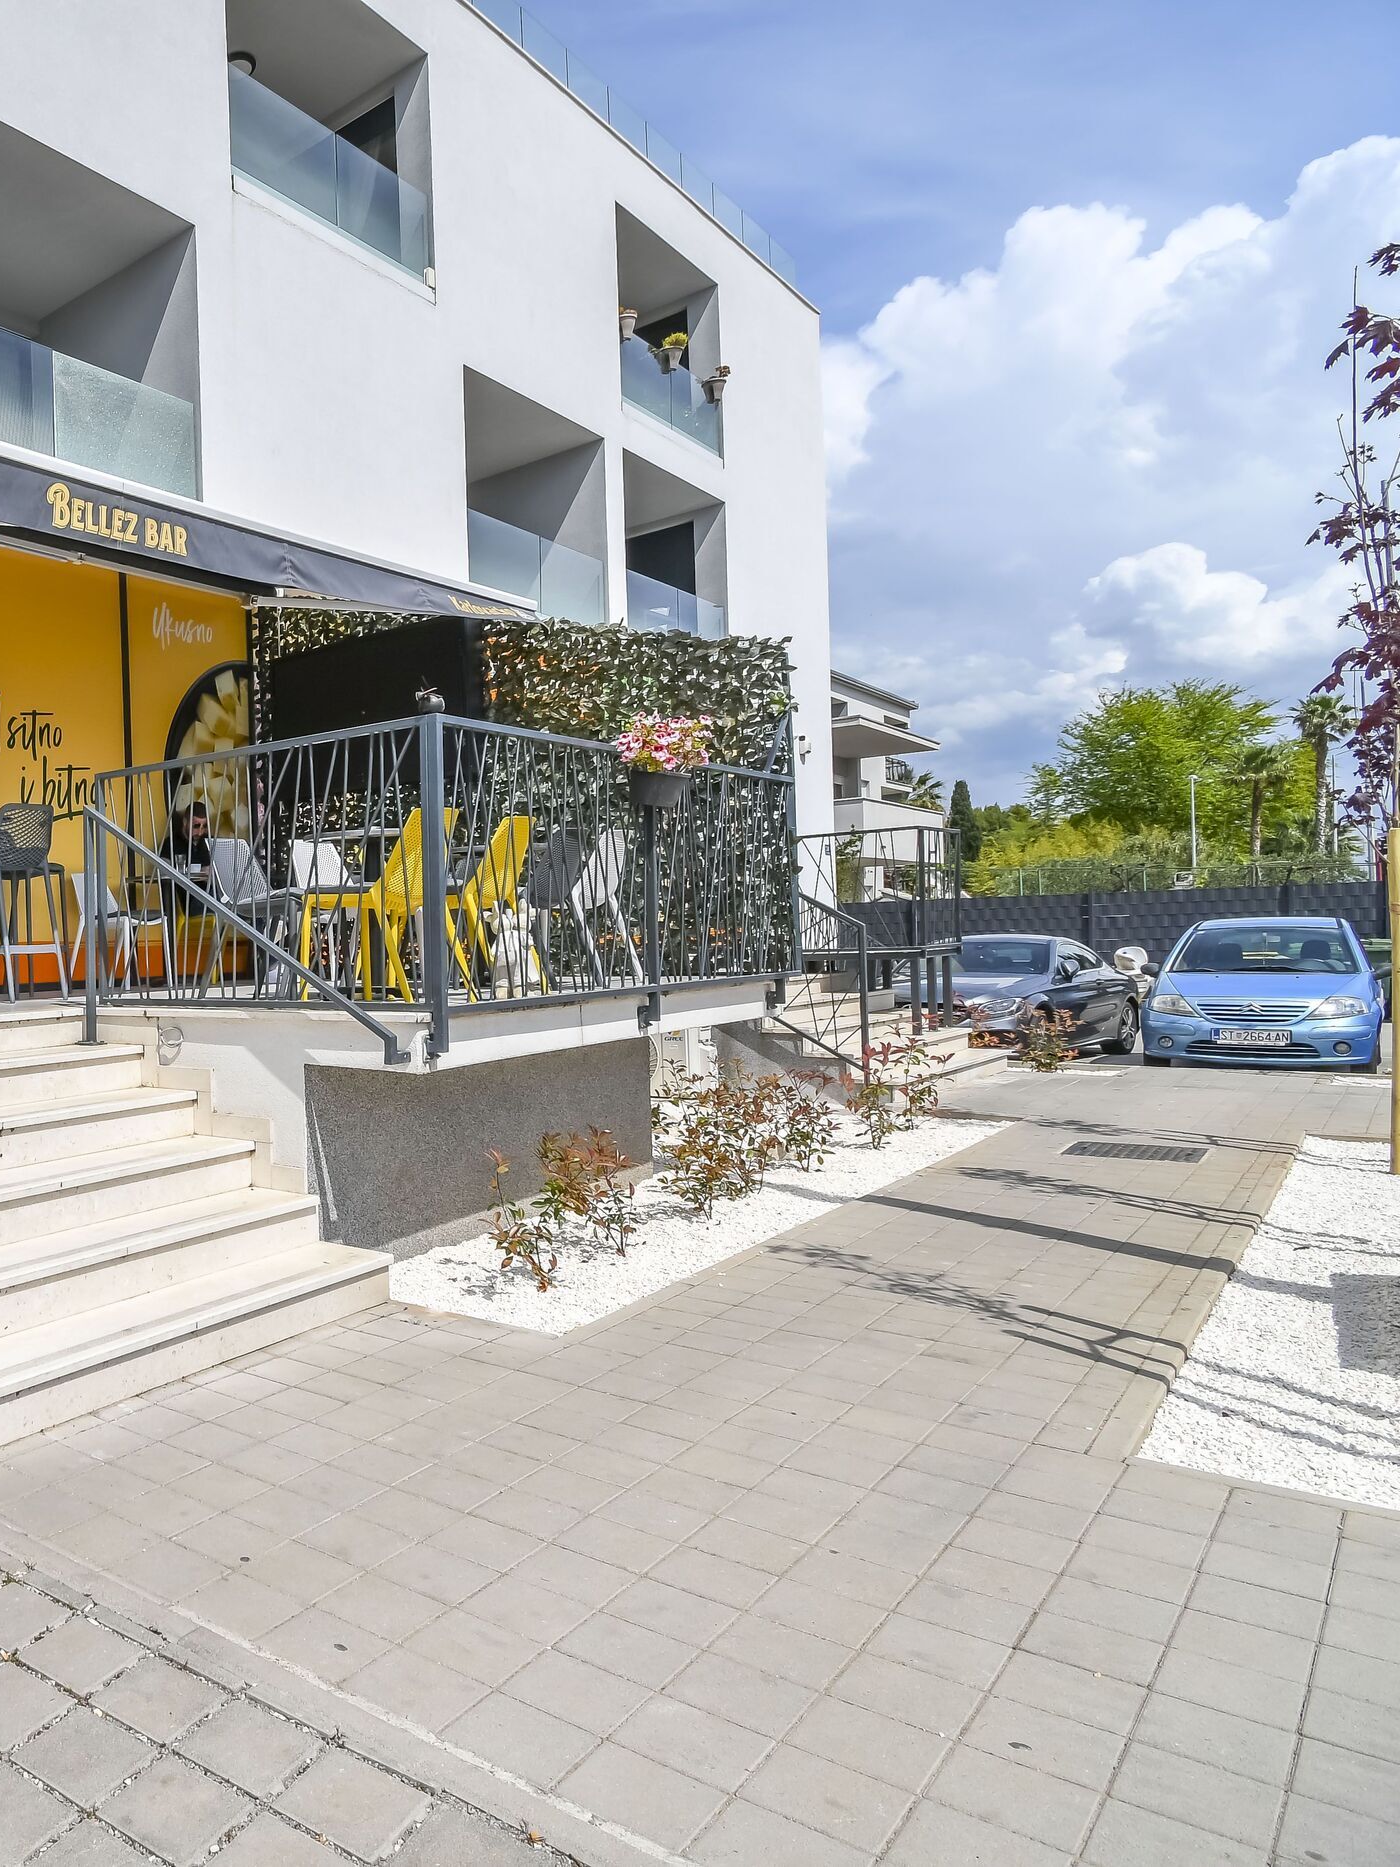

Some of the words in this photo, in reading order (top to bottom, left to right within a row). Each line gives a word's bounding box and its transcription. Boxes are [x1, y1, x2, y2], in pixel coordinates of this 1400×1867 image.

[144, 517, 189, 557] BAR
[152, 601, 214, 651] Ukusno
[6, 709, 63, 762] sitno
[1220, 1030, 1235, 1041] ST
